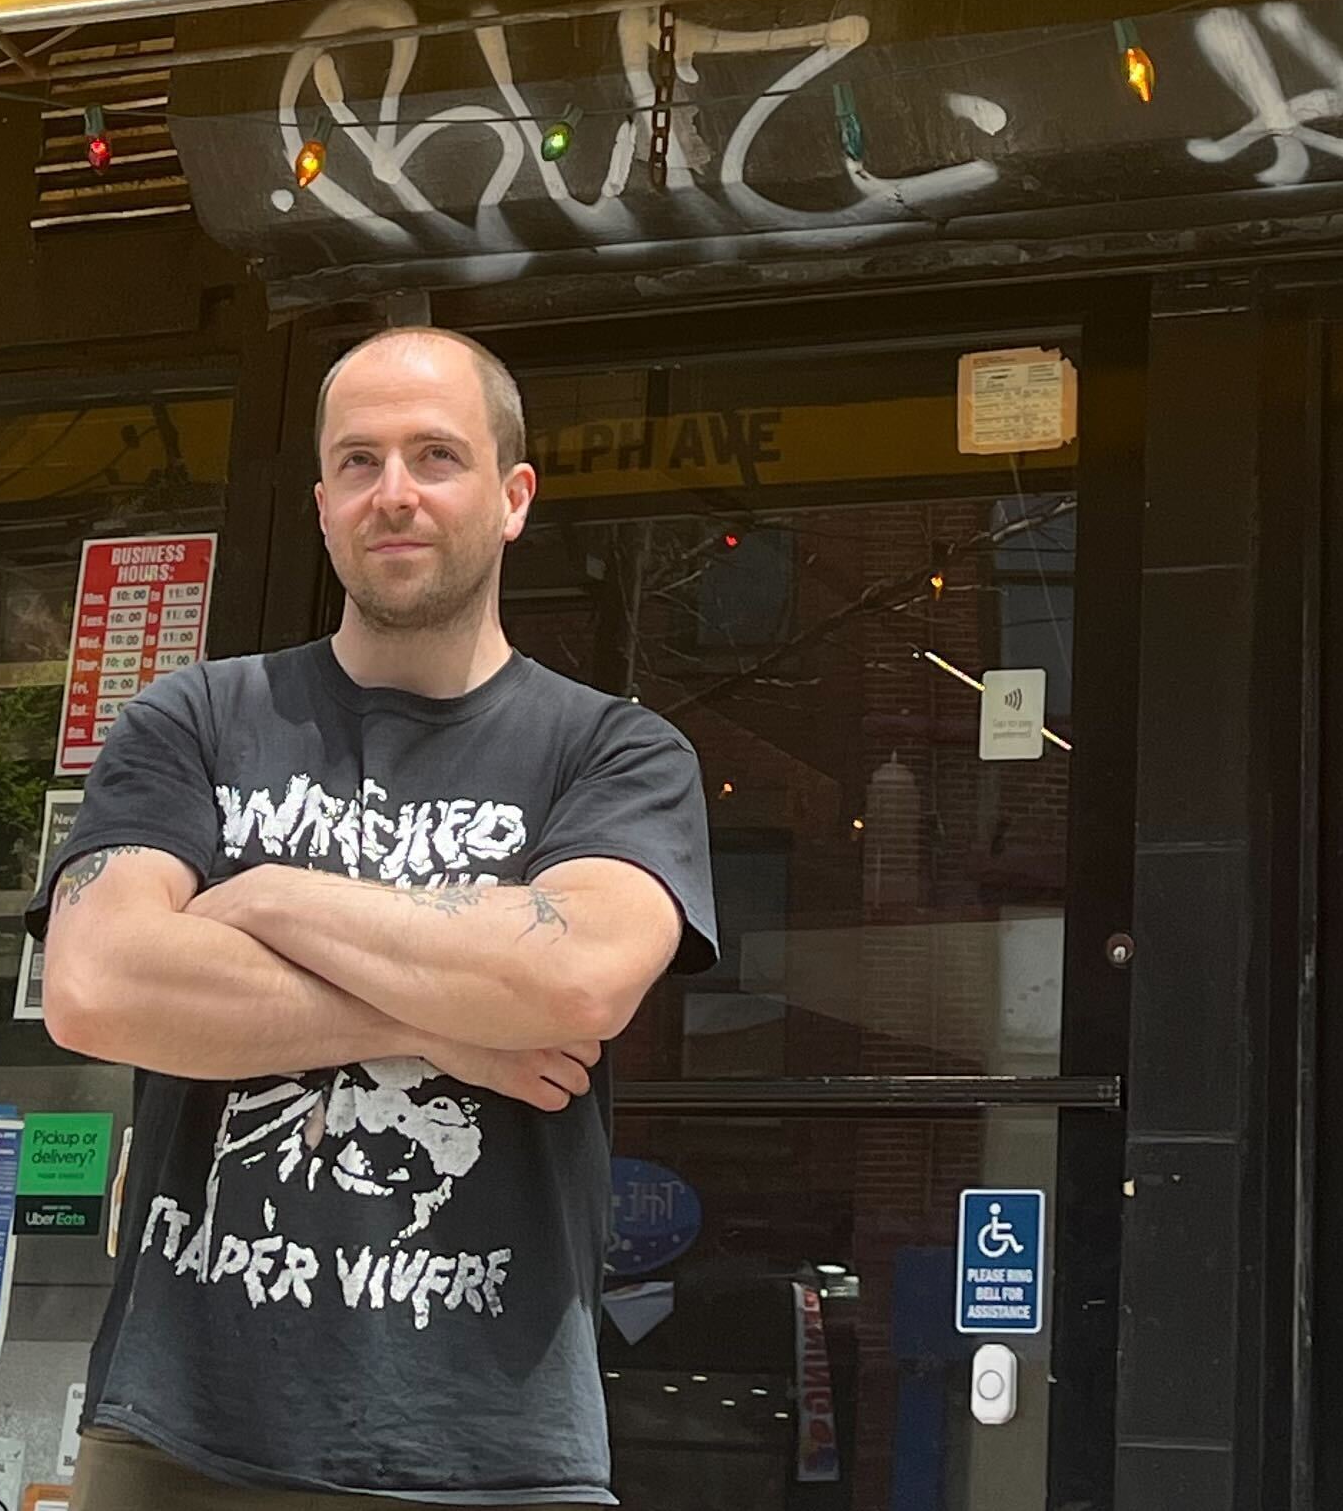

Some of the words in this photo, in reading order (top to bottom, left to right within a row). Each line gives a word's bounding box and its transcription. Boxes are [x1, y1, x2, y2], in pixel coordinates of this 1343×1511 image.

[111, 545, 186, 566] BUSINESS
[33, 1129, 80, 1148] Pickup
[83, 1132, 98, 1145] or
[31, 1149, 97, 1168] delivery?
[25, 1211, 54, 1226] Uber
[56, 1212, 86, 1226] Eats
[966, 1268, 1005, 1283] PLEASE
[1006, 1268, 1033, 1283] RING
[975, 1287, 1001, 1301] BELL
[1002, 1287, 1024, 1301] FOR
[966, 1305, 1031, 1320] ASSISTANCE
